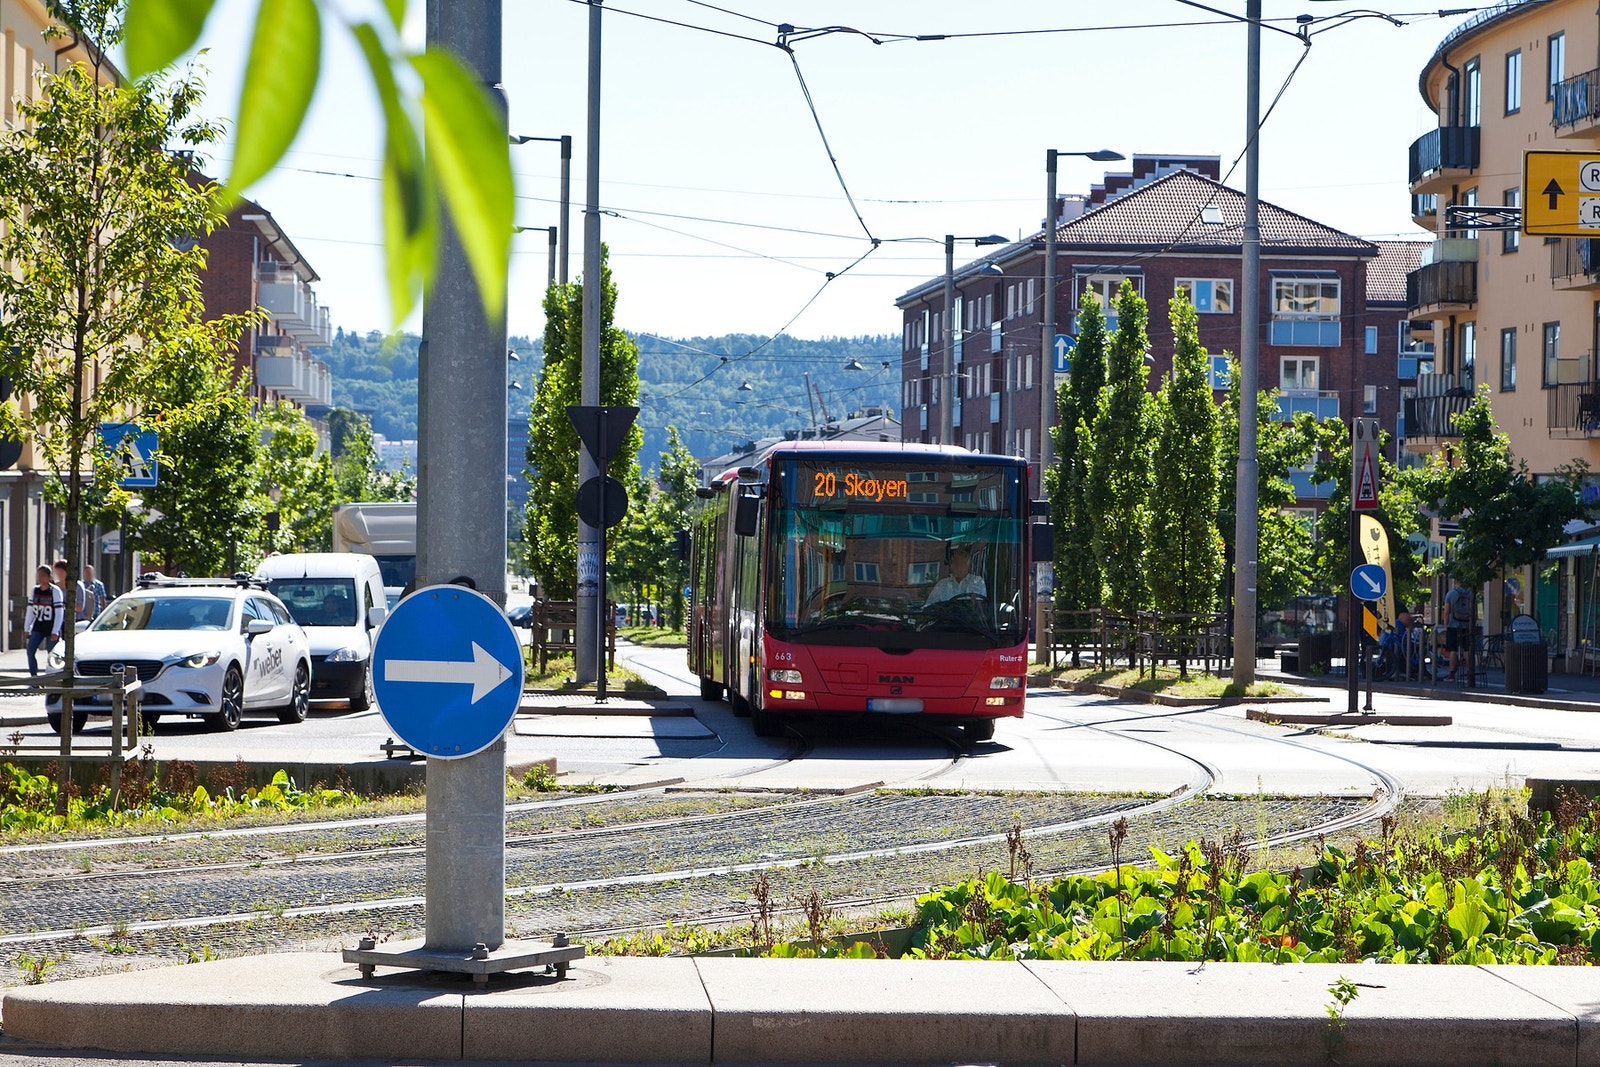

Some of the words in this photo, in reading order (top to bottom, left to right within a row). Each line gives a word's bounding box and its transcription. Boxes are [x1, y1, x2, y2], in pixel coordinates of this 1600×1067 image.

[814, 472, 836, 497] 20
[845, 473, 907, 502] Skøyen
[775, 652, 791, 660] 663
[879, 675, 914, 684] MAN
